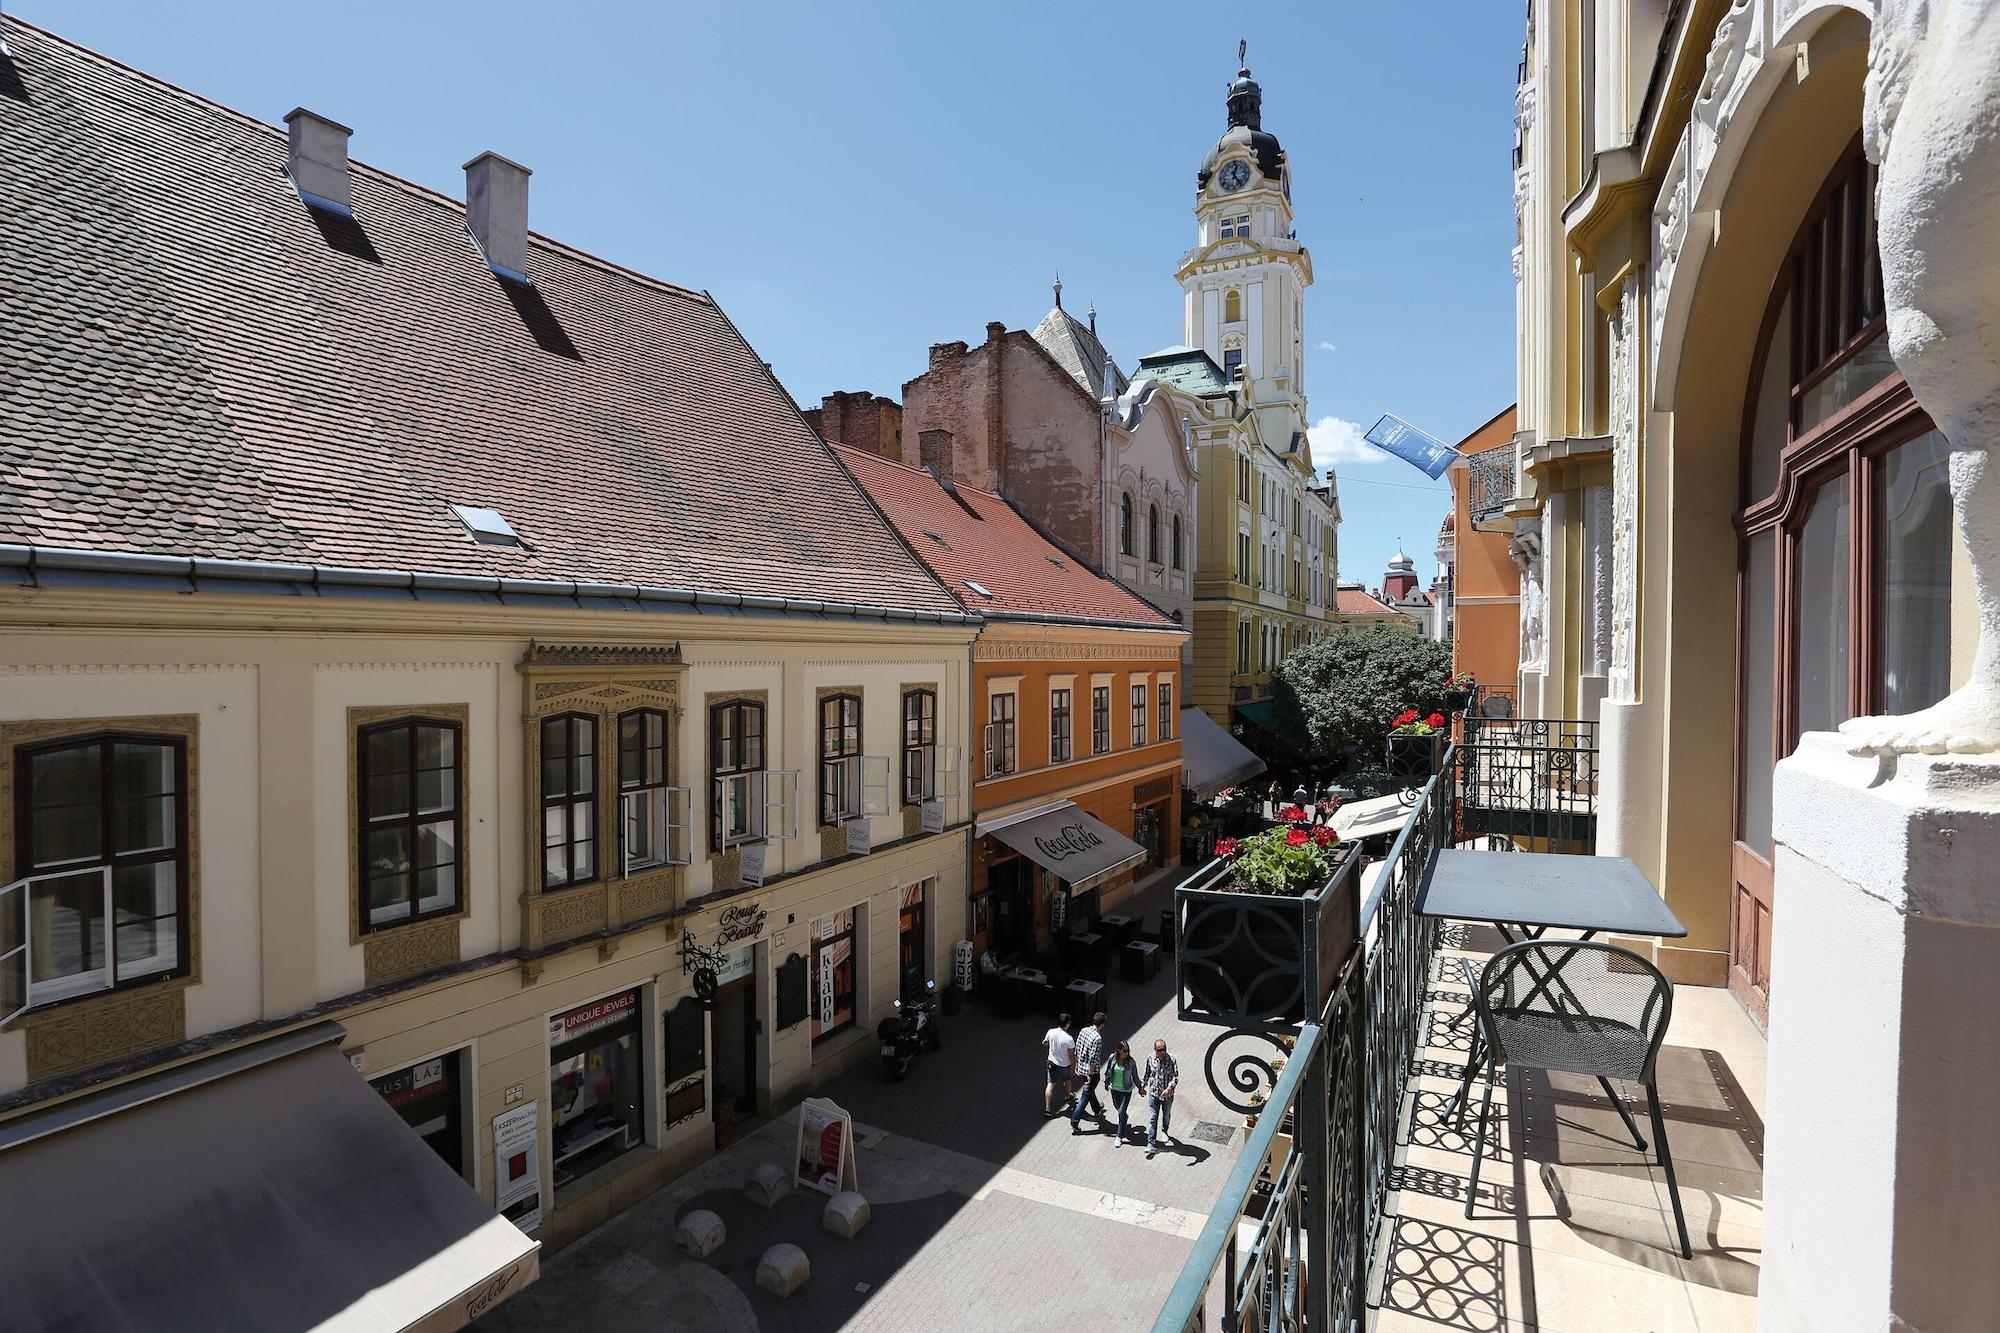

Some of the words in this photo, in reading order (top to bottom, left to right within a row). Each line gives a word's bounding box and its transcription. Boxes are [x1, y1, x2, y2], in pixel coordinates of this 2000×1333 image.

[720, 903, 760, 927] Rouge
[957, 948, 966, 985] BOLS
[566, 1007, 602, 1028] UNIQUE
[602, 994, 635, 1014] JEWELS
